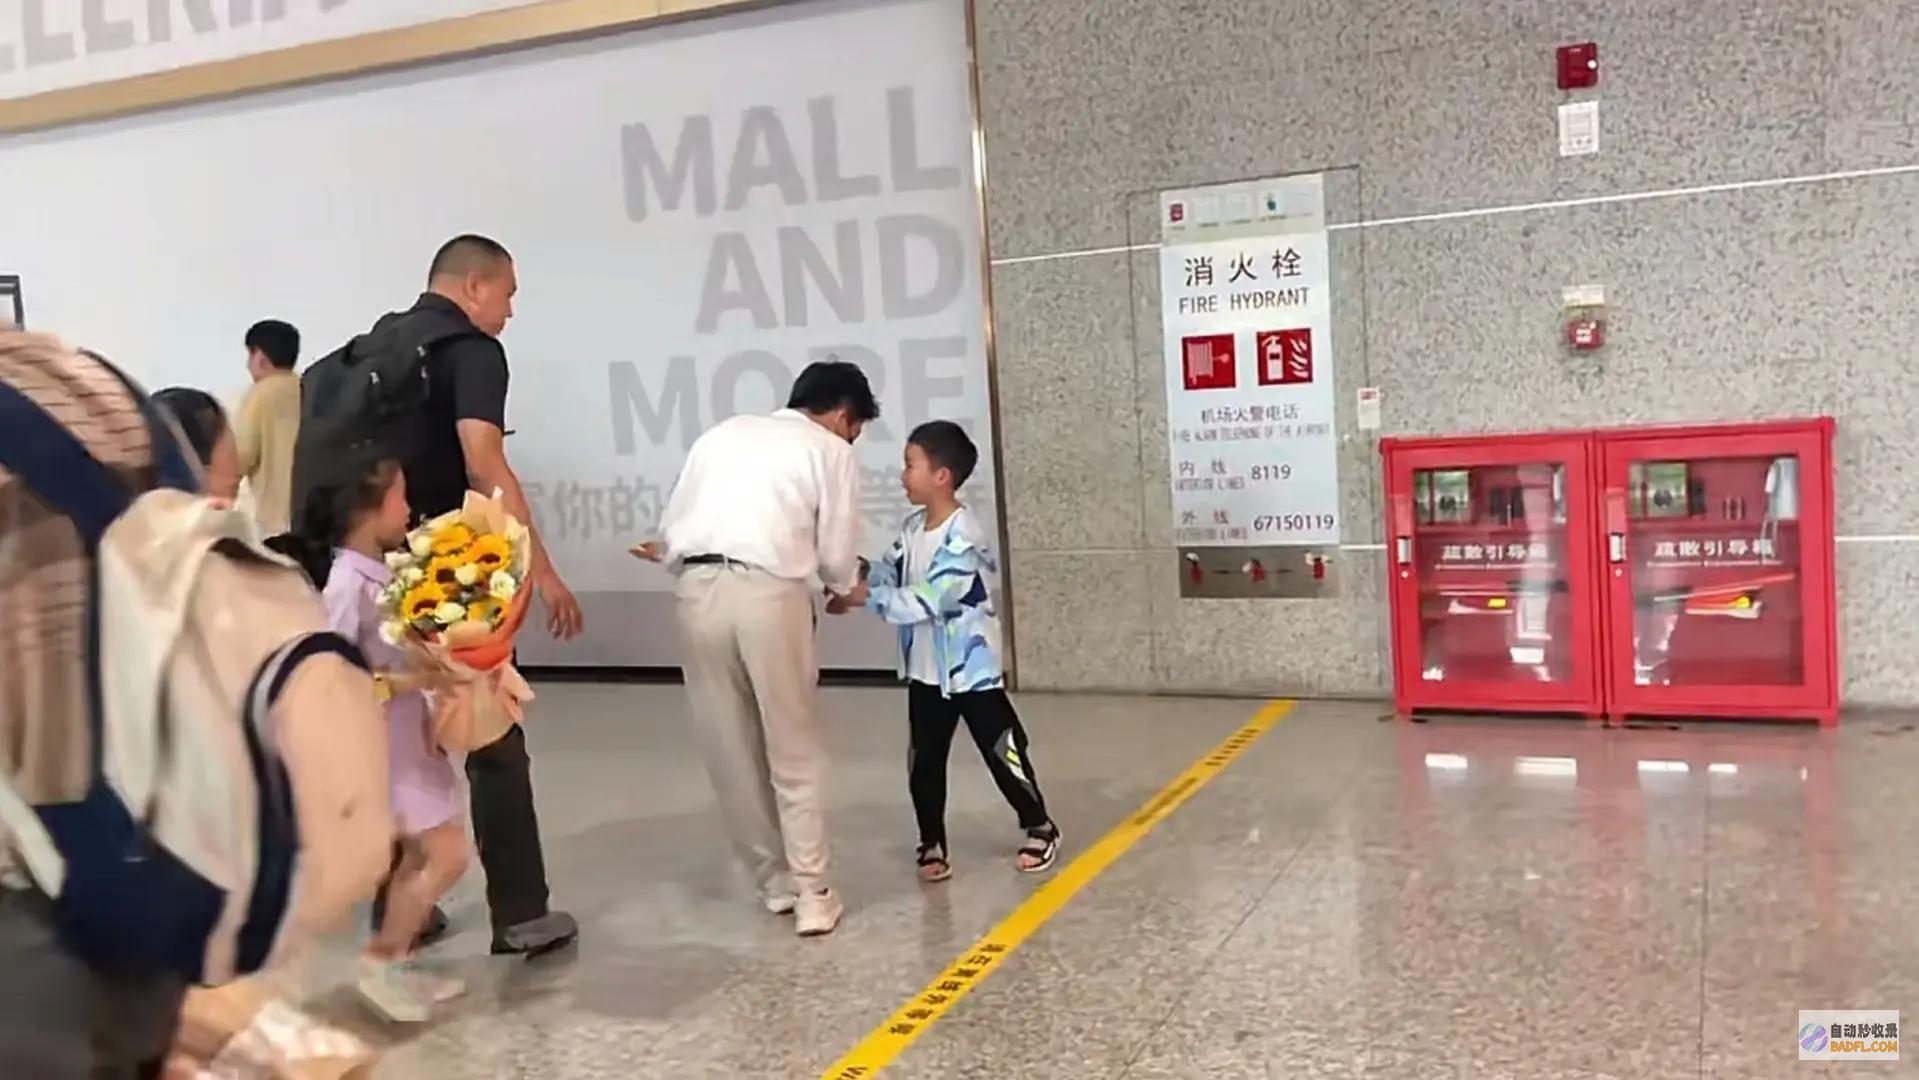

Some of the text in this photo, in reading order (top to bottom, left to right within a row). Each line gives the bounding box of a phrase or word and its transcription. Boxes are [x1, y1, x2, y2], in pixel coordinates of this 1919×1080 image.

[620, 86, 960, 222] MALL
[695, 213, 965, 334] AND
[1184, 247, 1302, 286] 消火栓
[1178, 287, 1310, 315] FIRE HYDRANT
[1201, 404, 1299, 424] 机场火警电话
[1179, 459, 1291, 481] 内线 8119
[1253, 514, 1335, 532] 67150119
